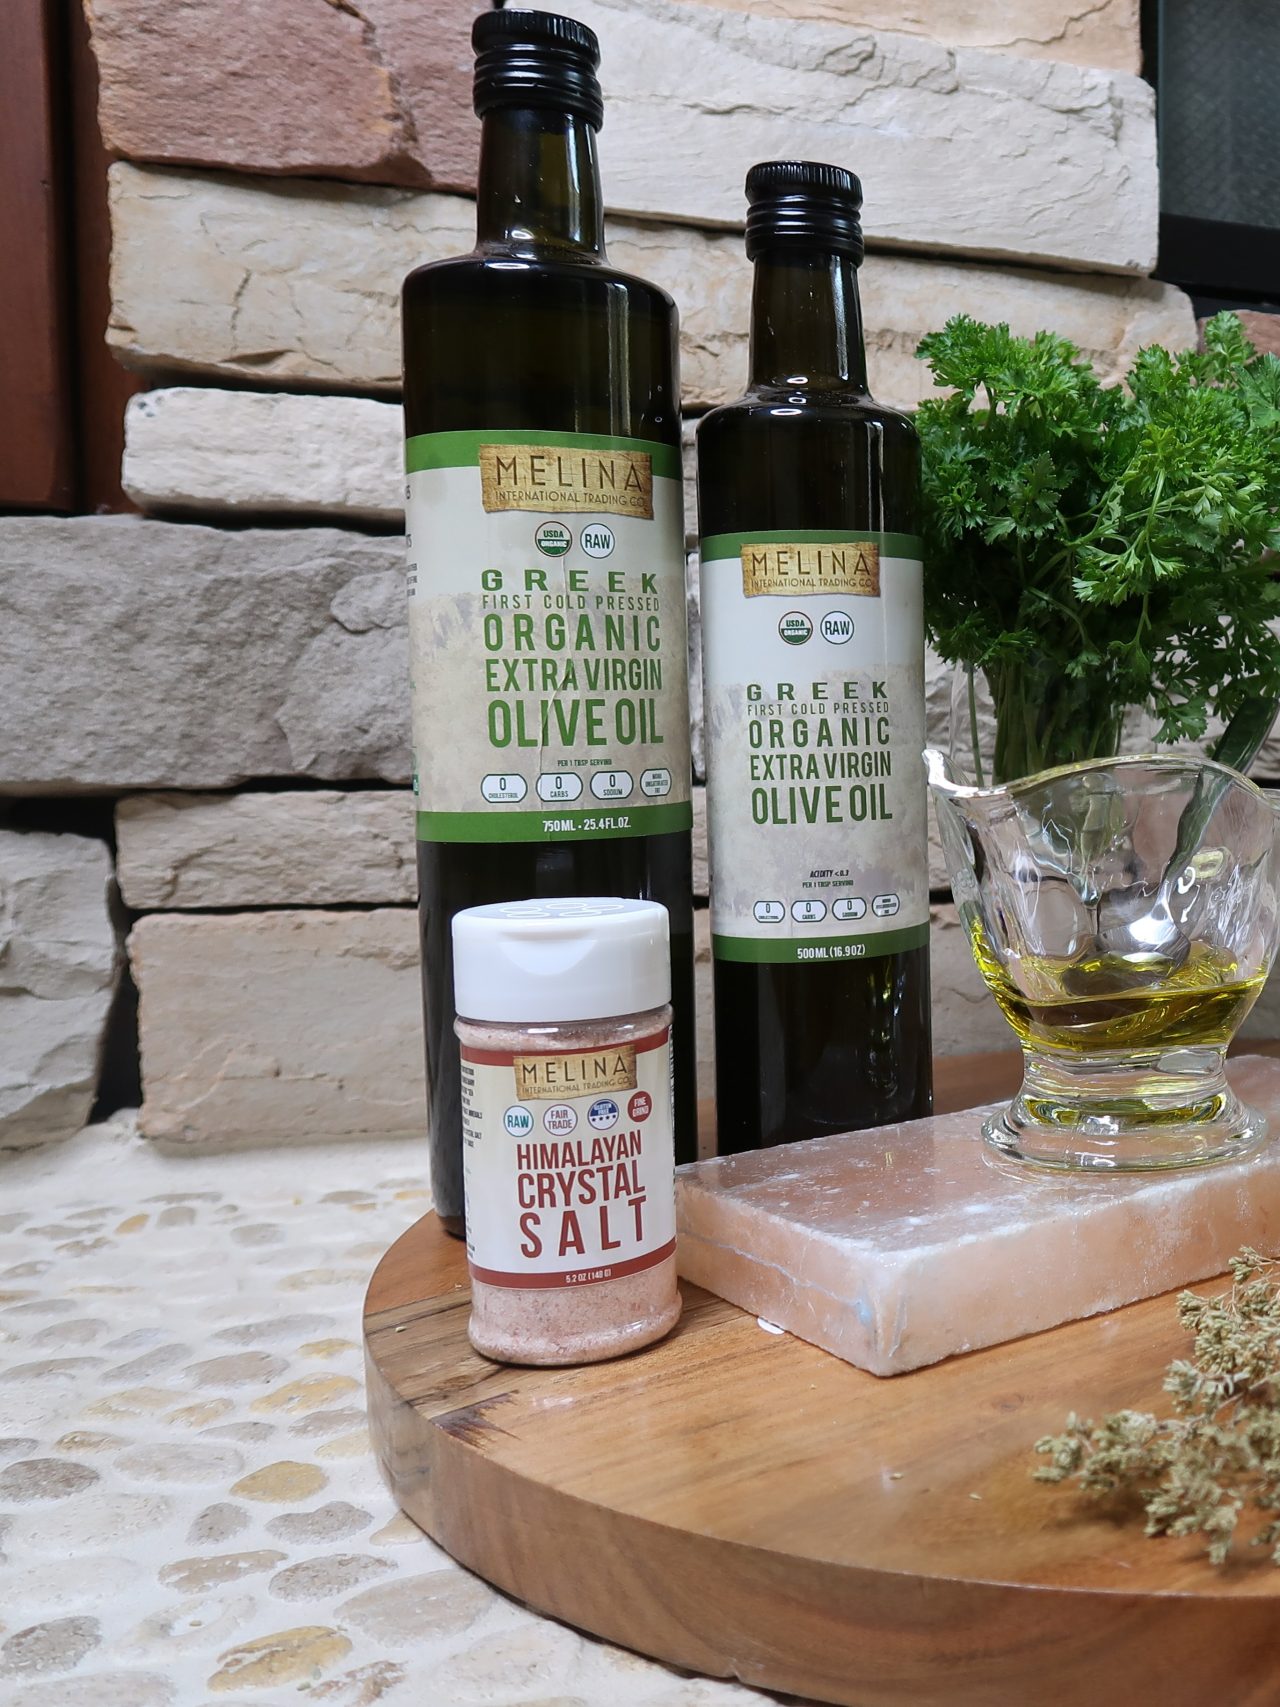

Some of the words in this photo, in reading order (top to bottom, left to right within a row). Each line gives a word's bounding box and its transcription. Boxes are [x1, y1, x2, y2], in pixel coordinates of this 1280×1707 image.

[496, 455, 643, 492] MELINA
[495, 490, 581, 503] INTERNATIONAL
[584, 493, 628, 507] TRADING
[543, 530, 564, 538] USDA
[585, 533, 611, 549] RAW
[751, 550, 871, 576] MELINA
[481, 569, 658, 594] GREEK
[751, 578, 817, 588] INTERNATIONAL
[819, 578, 856, 587] TRADING
[482, 594, 532, 610] FIRST
[544, 595, 586, 610] COLD
[596, 596, 660, 612] PRESSED
[786, 619, 805, 627] USDA
[824, 620, 850, 636] RAW
[484, 613, 661, 652] ORGANIC
[485, 658, 578, 692] EXTRA
[584, 658, 663, 690] VIRGIN
[746, 681, 888, 701] GREEK
[747, 704, 783, 716] FIRST
[791, 703, 825, 715] COLD
[834, 702, 889, 714] PRESSED
[488, 699, 607, 748] OLIVE
[615, 698, 664, 745] OIL
[749, 717, 890, 749] ORGANIC
[557, 759, 568, 767] PER
[750, 753, 820, 781] EXTRA
[823, 751, 892, 779] VIRGIN
[499, 777, 507, 791] 0
[555, 775, 562, 789] 0
[609, 774, 616, 788] 0
[550, 790, 569, 798] CARBS
[751, 785, 844, 825] OLIVE
[849, 783, 893, 822] OIL
[765, 902, 771, 913] 0
[805, 902, 812, 913] 0
[847, 900, 853, 911] 0
[522, 1054, 628, 1084] MELINA
[522, 1083, 580, 1094] INTERNATIONAL
[583, 1079, 616, 1090] TRADING
[507, 1114, 530, 1129] RAW
[550, 1110, 569, 1119] FAIR
[547, 1119, 573, 1130] TRADE
[517, 1130, 642, 1170] HIMALAYAN
[517, 1160, 646, 1208] CRYSTAL
[519, 1195, 647, 1259] SALT
[577, 1273, 587, 1281] OZ
